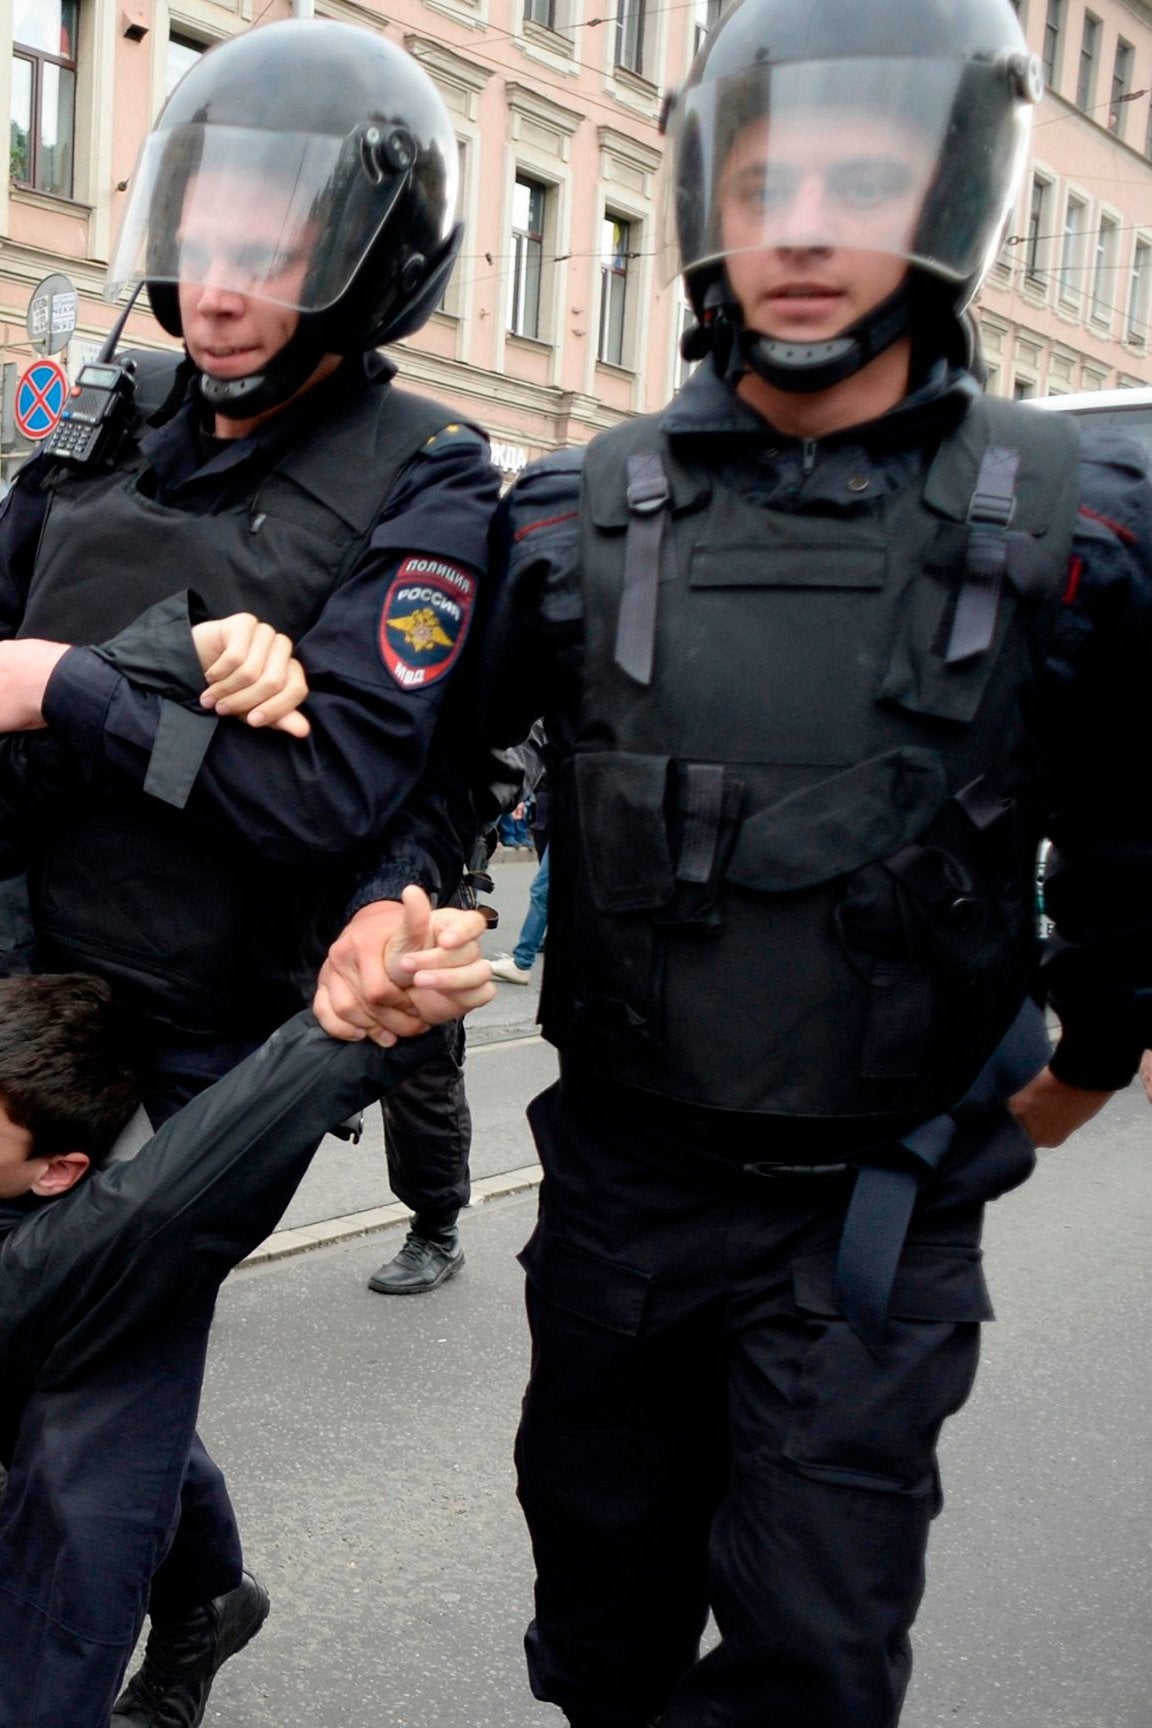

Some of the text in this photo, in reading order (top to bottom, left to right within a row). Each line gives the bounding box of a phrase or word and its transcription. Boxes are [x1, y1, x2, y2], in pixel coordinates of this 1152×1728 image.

[405, 559, 471, 594] ПОЛИЦИЯ
[397, 587, 460, 621] РОССИЯ
[394, 661, 426, 685] МВД
